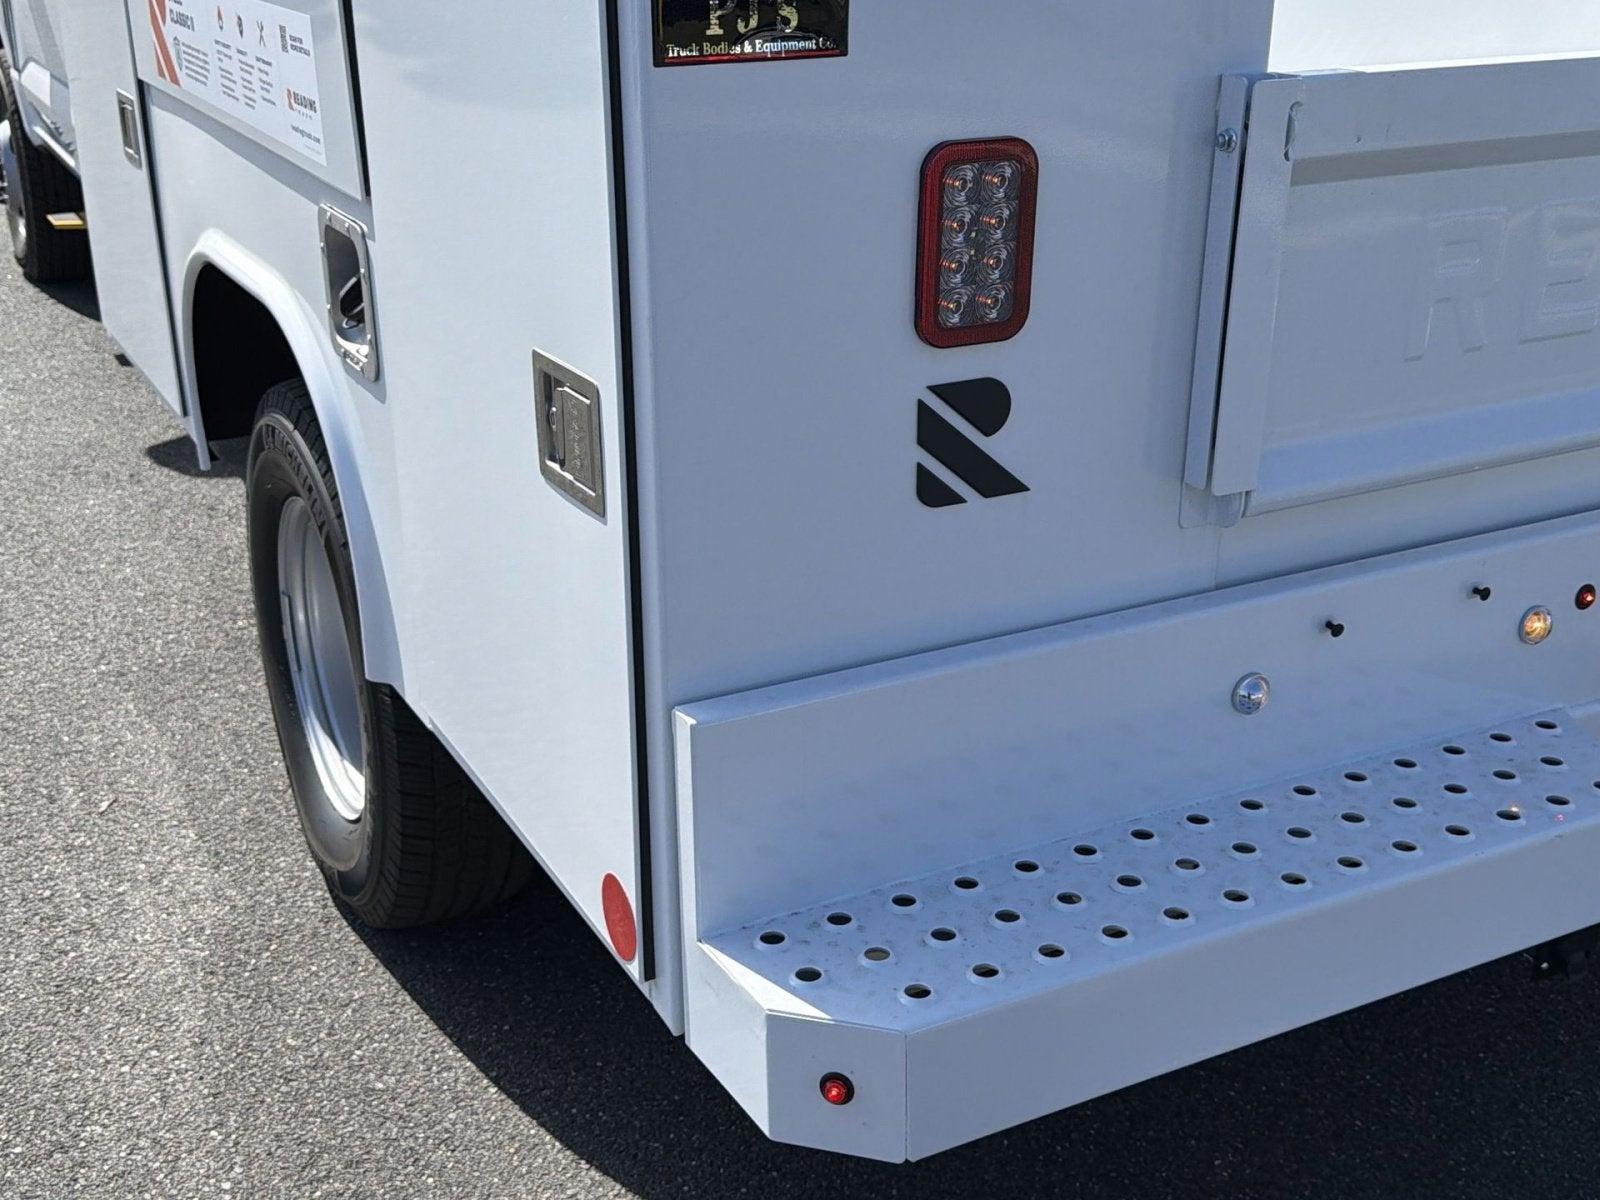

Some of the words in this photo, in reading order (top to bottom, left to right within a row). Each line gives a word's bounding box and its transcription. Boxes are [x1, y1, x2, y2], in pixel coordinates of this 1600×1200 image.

[667, 43, 700, 57] Truck
[703, 42, 741, 56] Bodies
[743, 42, 753, 53] &
[755, 37, 816, 57] Equipment
[293, 90, 317, 114] READING
